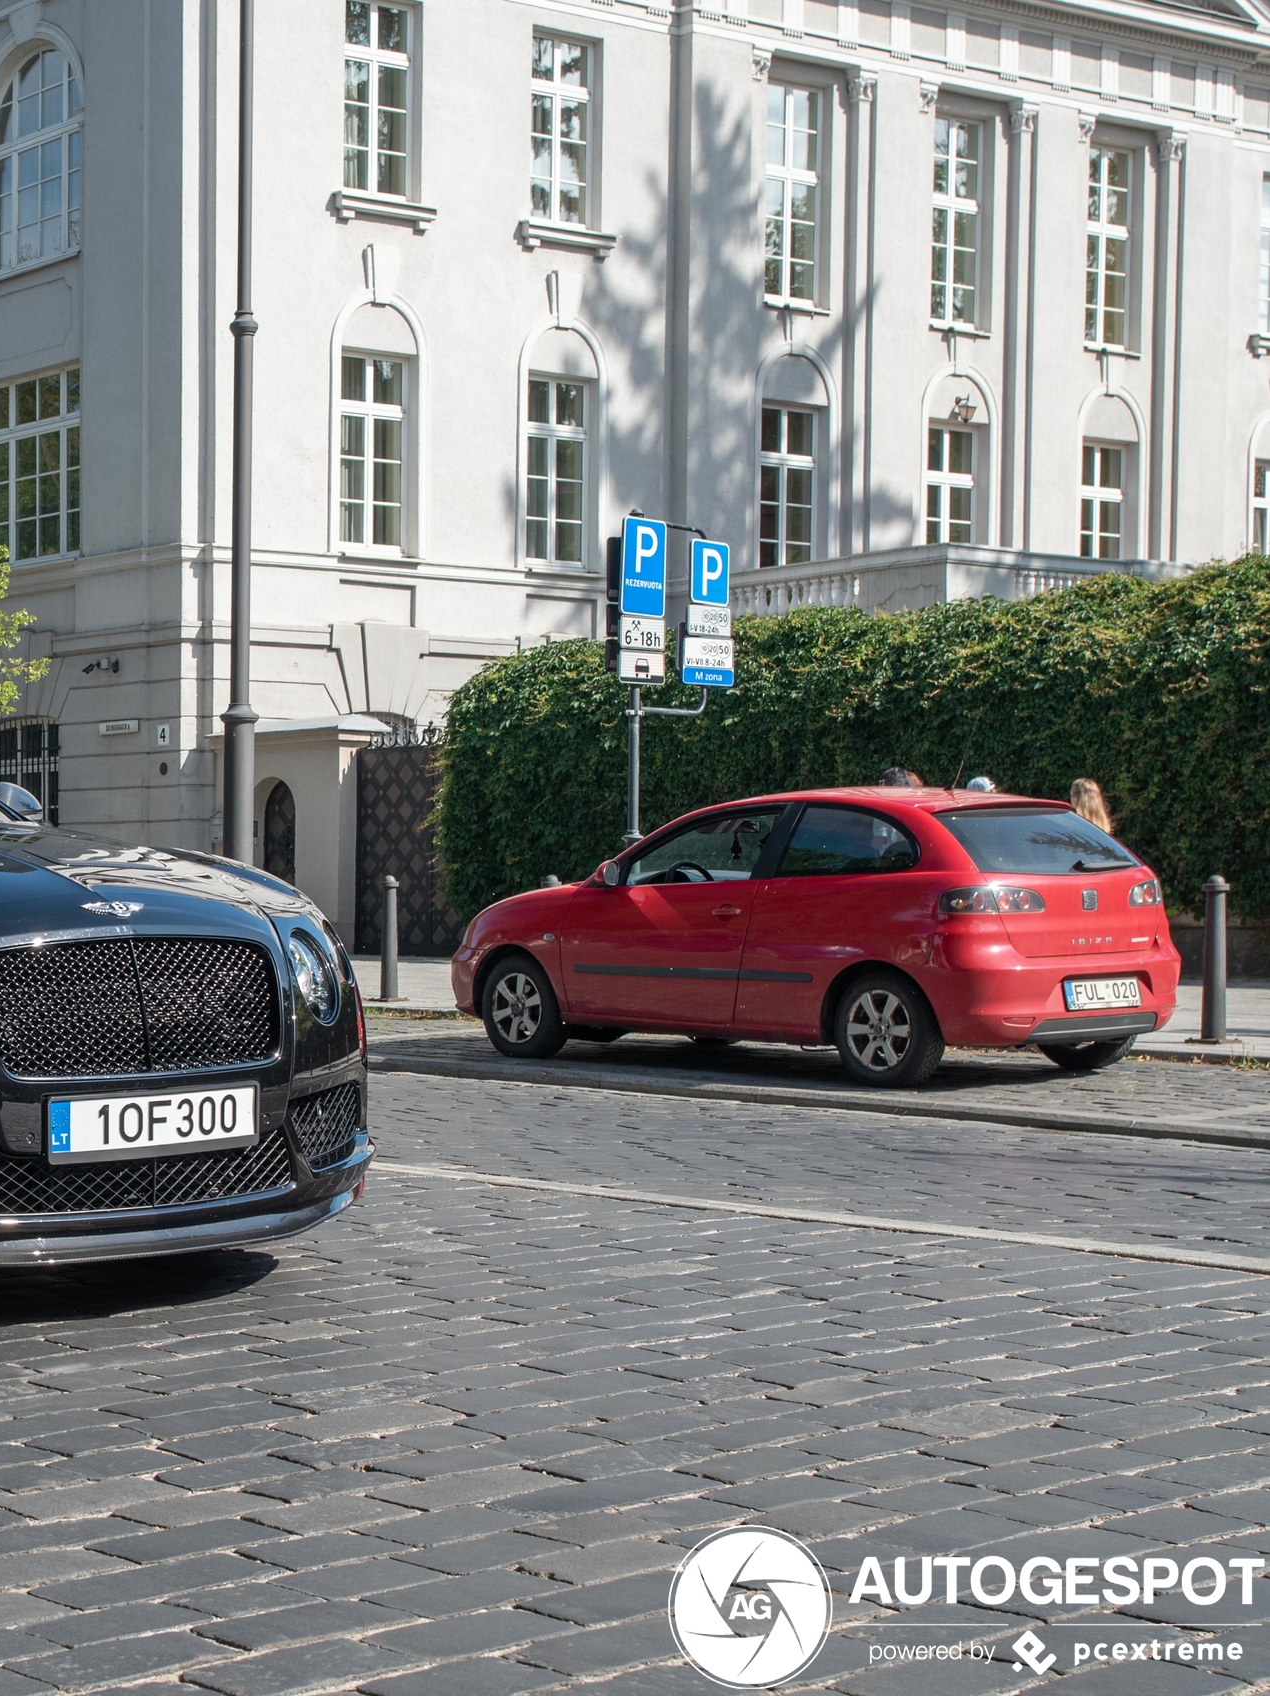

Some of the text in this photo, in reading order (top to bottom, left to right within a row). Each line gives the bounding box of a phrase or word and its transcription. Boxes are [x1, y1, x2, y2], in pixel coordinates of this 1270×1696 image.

[635, 525, 658, 573] P
[701, 547, 723, 597] P
[625, 578, 663, 591] REZERVUOTA
[718, 613, 728, 623] 50
[699, 624, 720, 634] 18-24h
[709, 645, 718, 653] 20
[718, 645, 729, 655] 50
[686, 657, 725, 667] VI-VII 8-24h
[695, 671, 723, 682] M zona
[159, 727, 166, 742] 4
[1071, 936, 1112, 945] IBIZA
[1074, 983, 1105, 1002] FUL
[1112, 981, 1137, 999] 020
[51, 1133, 68, 1146] LT
